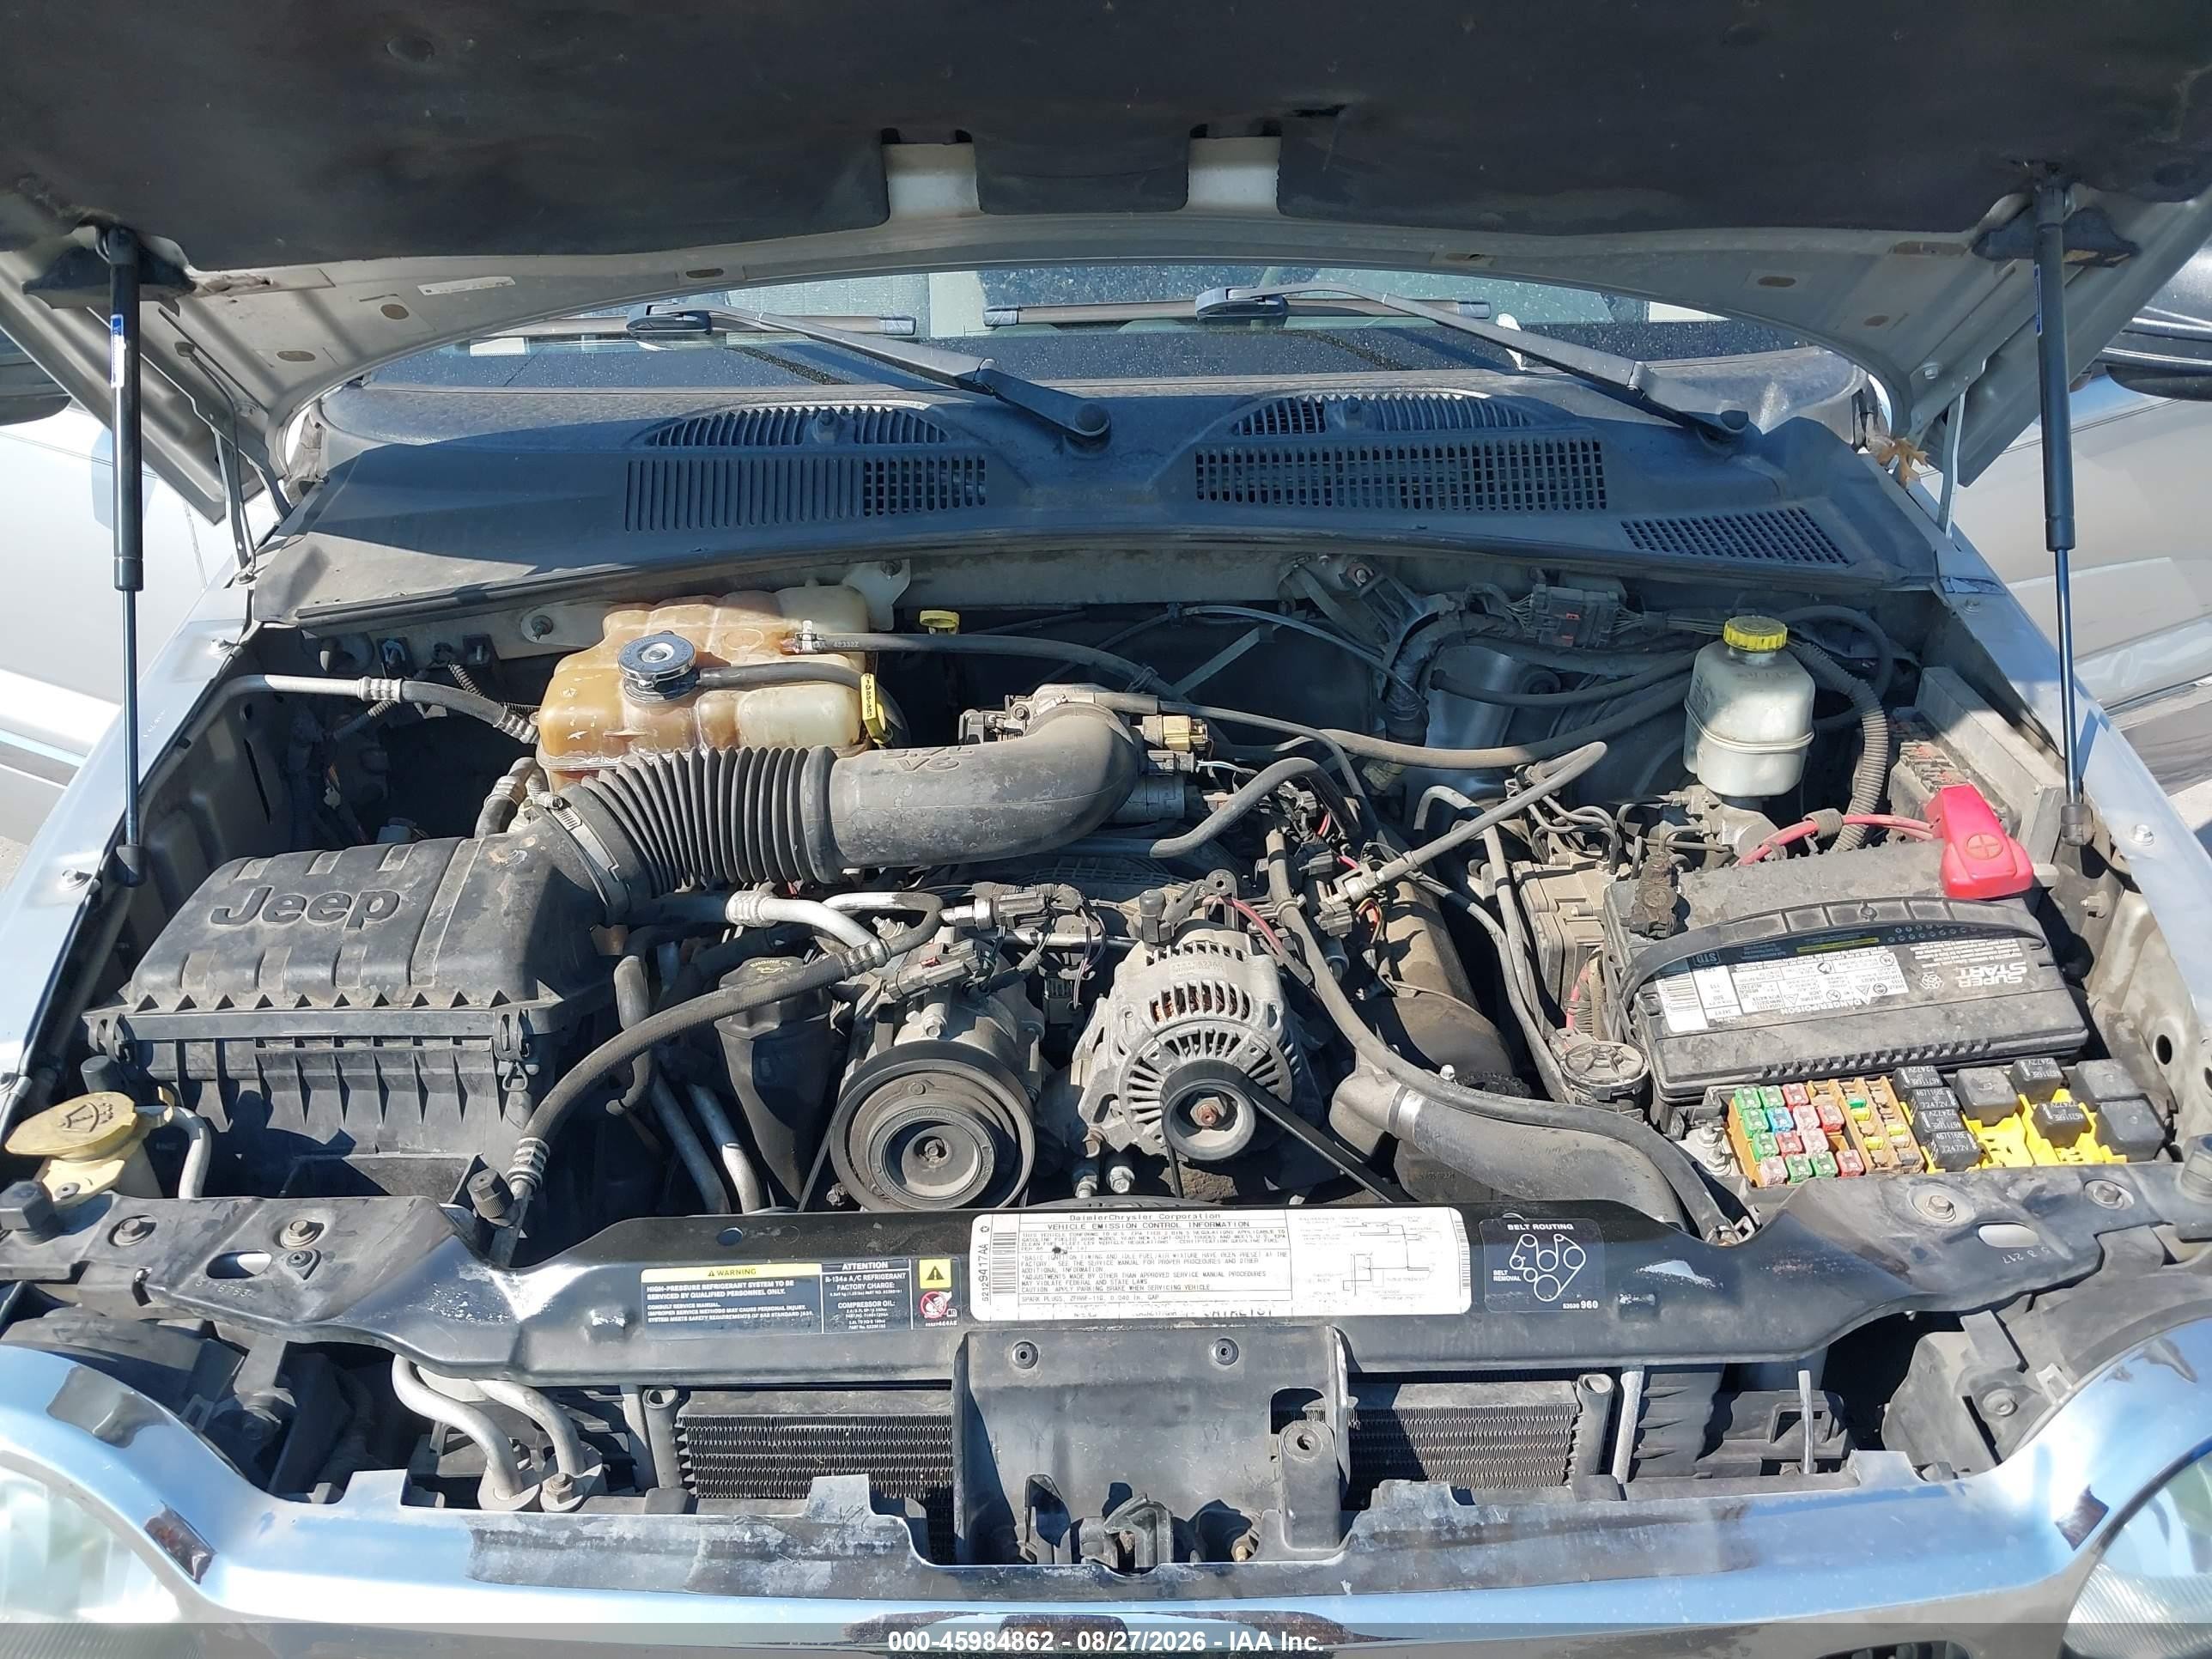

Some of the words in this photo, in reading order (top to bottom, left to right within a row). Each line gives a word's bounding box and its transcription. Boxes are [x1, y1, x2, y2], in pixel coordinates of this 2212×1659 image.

[895, 757, 961, 772] V6
[209, 885, 401, 931] Jeep
[1960, 962, 2027, 979] START
[1958, 973, 2023, 988] SUPER
[1780, 999, 1862, 1014] DANGER/POISON
[842, 1261, 888, 1271] ATTENTION
[863, 1273, 907, 1281] REFRIGERANT
[647, 1284, 701, 1292] HIGH-PRESSURE
